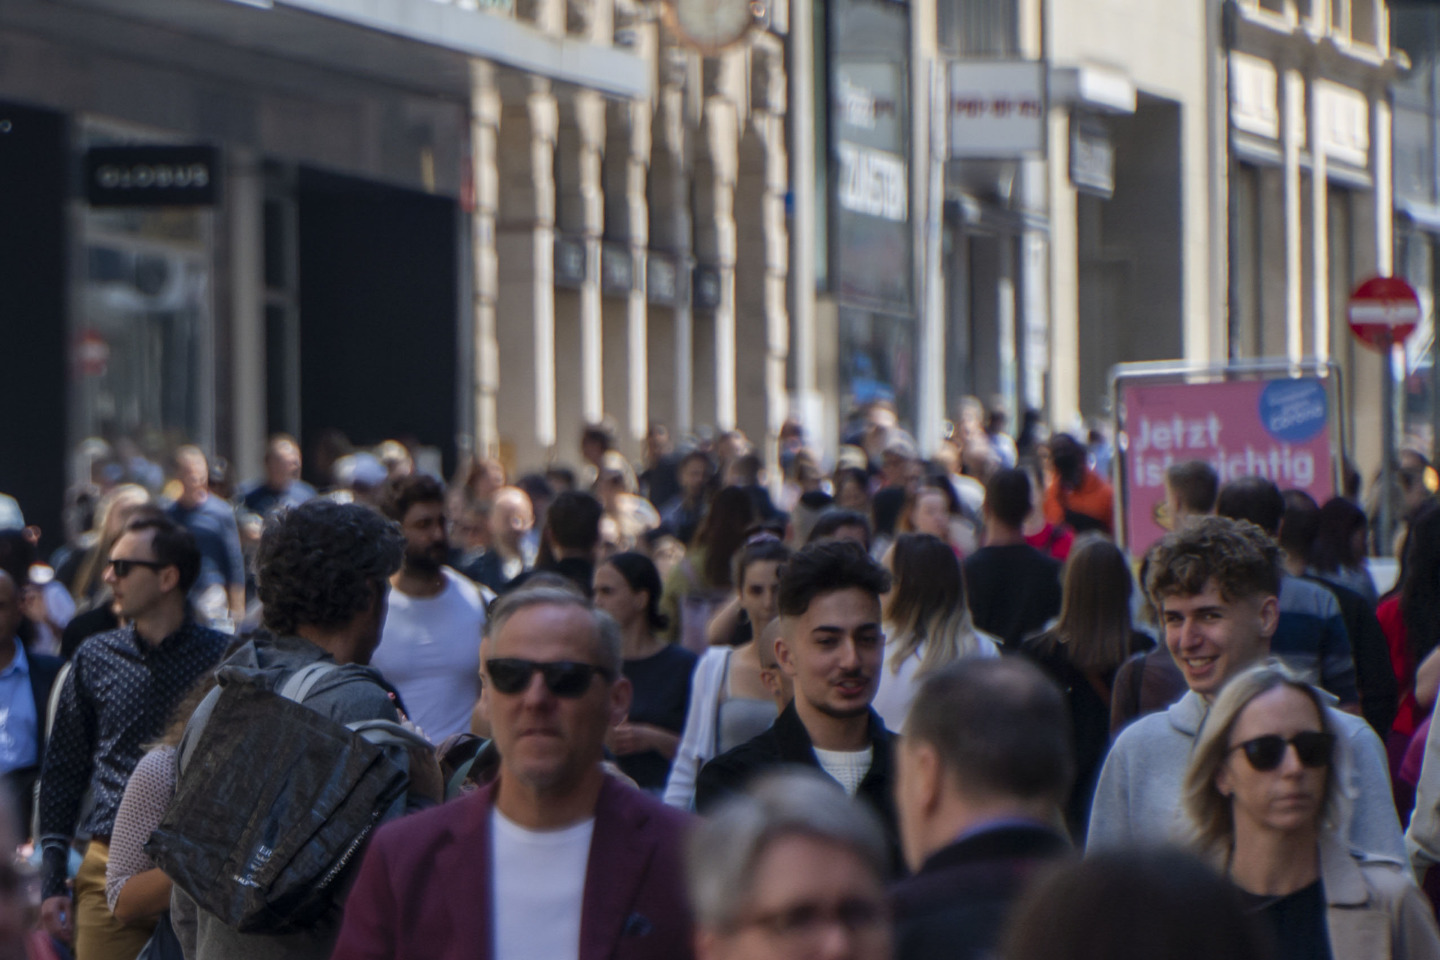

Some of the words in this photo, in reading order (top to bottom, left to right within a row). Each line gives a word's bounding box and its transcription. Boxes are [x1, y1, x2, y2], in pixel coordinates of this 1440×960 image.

[96, 164, 209, 188] GLOBUS
[1133, 411, 1221, 452] Jetzt
[1209, 444, 1315, 488] ichtig
